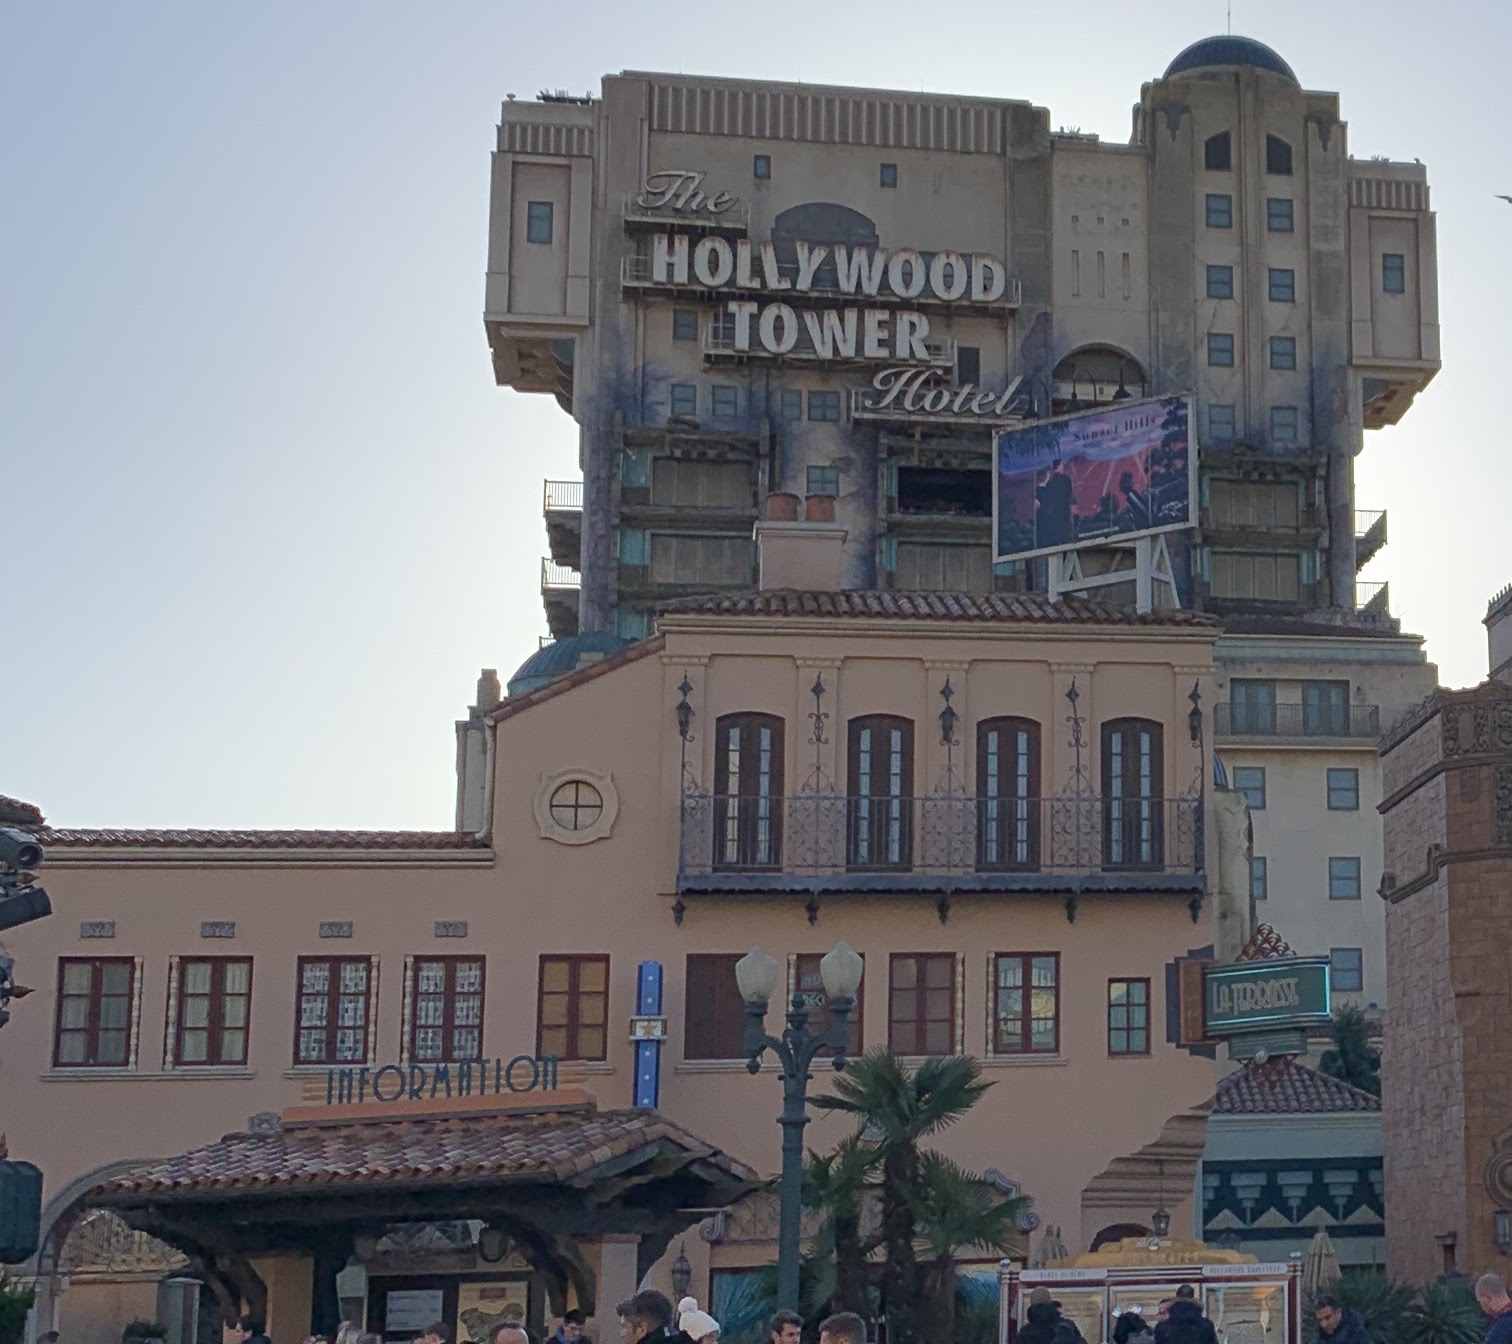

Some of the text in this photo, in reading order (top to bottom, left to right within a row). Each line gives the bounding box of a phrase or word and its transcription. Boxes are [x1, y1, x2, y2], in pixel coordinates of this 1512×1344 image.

[636, 169, 739, 214] The
[652, 233, 1006, 302] HOLLYWOOD
[727, 300, 932, 362] TOWER
[864, 367, 1024, 415] Hotel
[1124, 414, 1157, 432] Hills
[326, 1055, 558, 1105] INFORMATION
